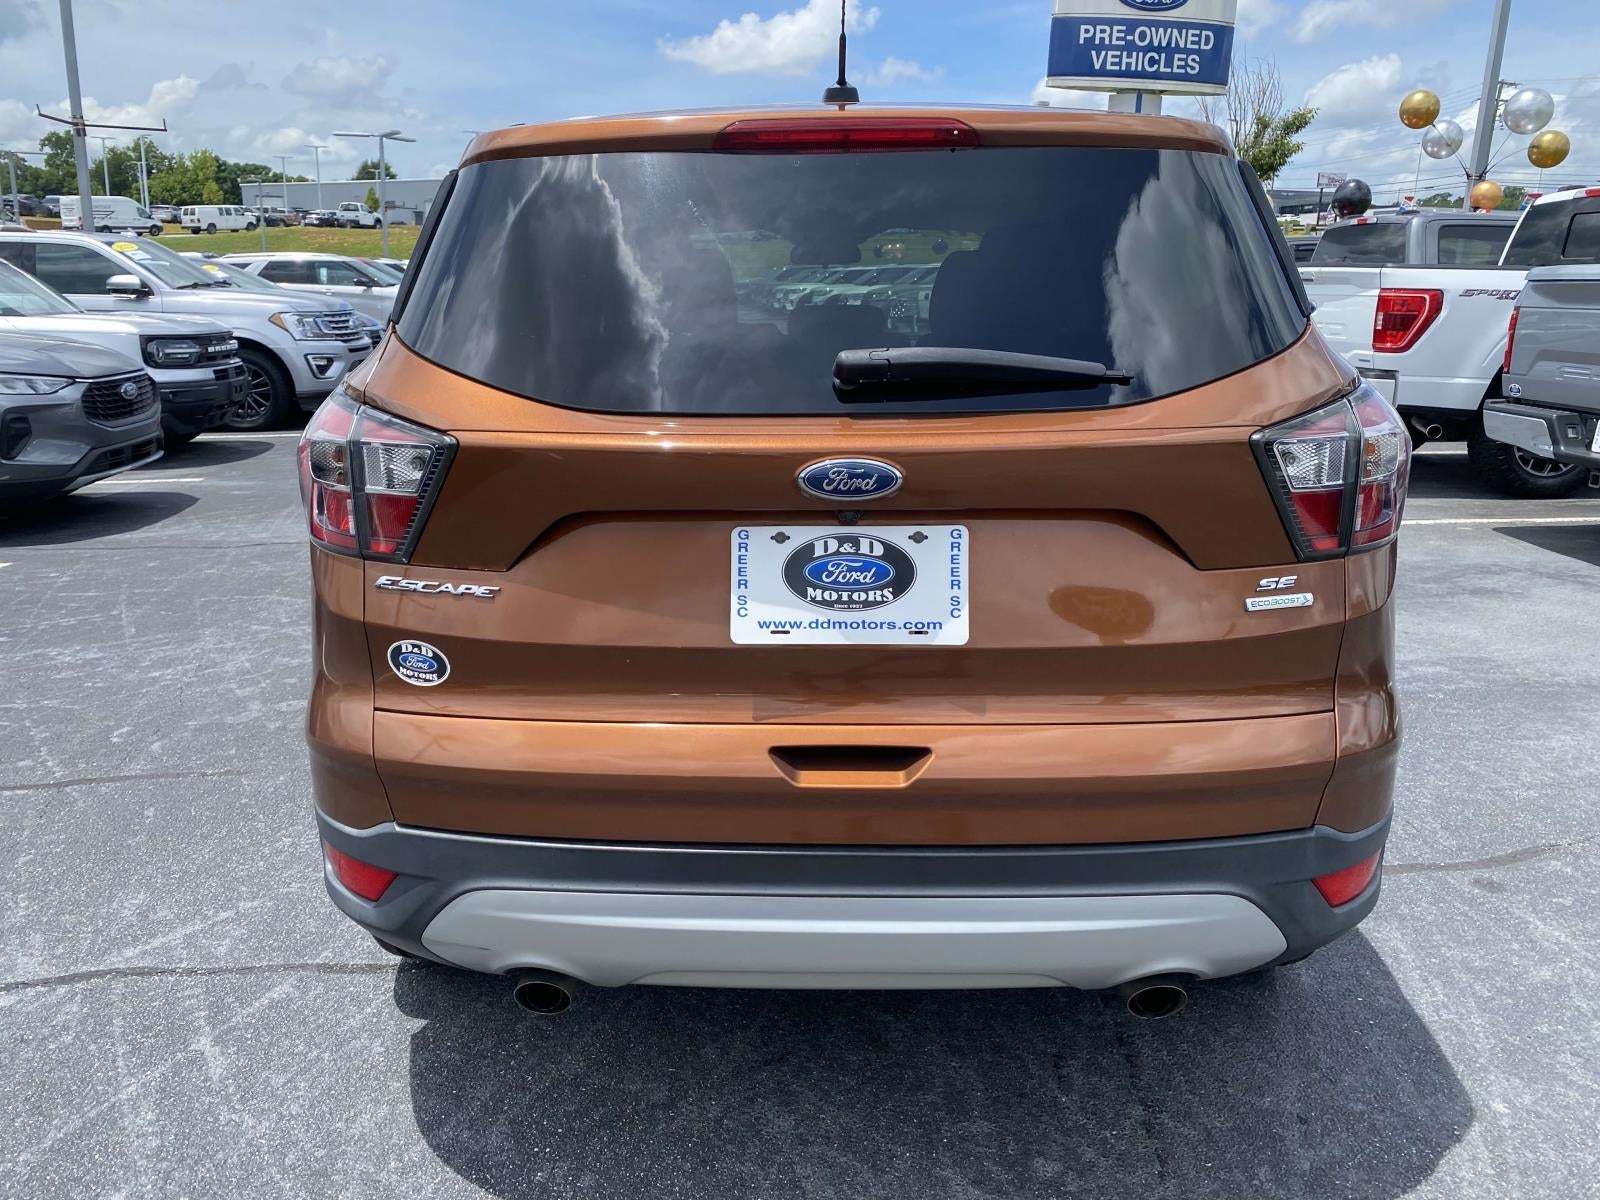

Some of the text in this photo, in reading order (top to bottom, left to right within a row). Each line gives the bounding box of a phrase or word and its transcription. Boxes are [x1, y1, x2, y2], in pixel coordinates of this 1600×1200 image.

[1079, 25, 1214, 50] PRE-OWNED
[1091, 50, 1200, 74] VEHICLES
[822, 467, 878, 491] Ford
[812, 537, 884, 557] D&D
[737, 529, 749, 617] GREER SC
[821, 560, 876, 583] Ford
[950, 529, 962, 618] GREER SC
[375, 576, 501, 597] ESCAPE
[1256, 575, 1298, 592] SE
[806, 586, 894, 602] MOTORS
[757, 618, 943, 630] www.ddmotors.com
[401, 643, 433, 658] D&D
[406, 656, 430, 670] Ford
[400, 666, 438, 681] MOTORS
